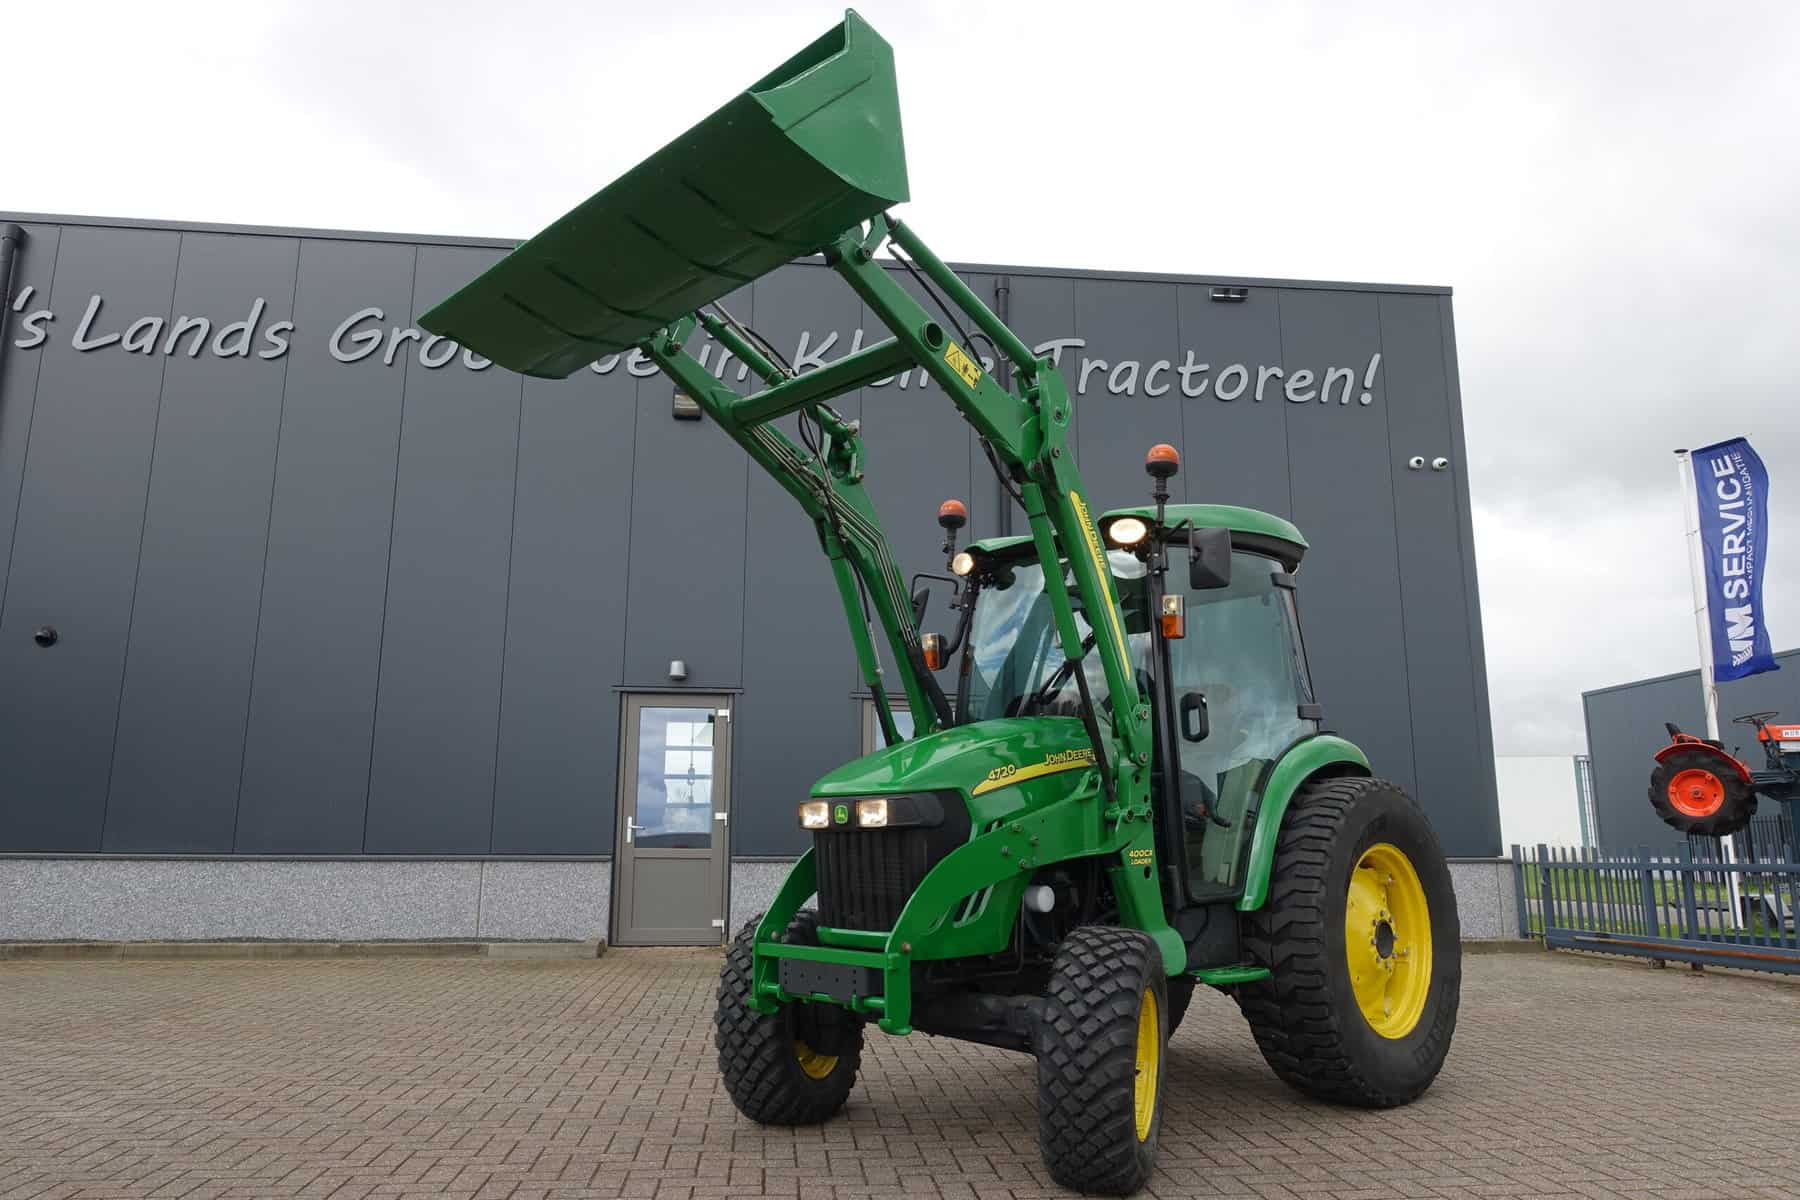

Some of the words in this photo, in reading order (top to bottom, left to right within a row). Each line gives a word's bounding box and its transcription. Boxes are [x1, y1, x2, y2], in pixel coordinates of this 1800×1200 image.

[12, 286, 56, 349] 's
[71, 295, 294, 359] Lands
[1033, 338, 1381, 405] Tractoren!
[1711, 454, 1750, 599] SERVICE
[988, 764, 1017, 780] 4720
[1044, 751, 1067, 765] JOHN
[1067, 748, 1095, 761] DEERE
